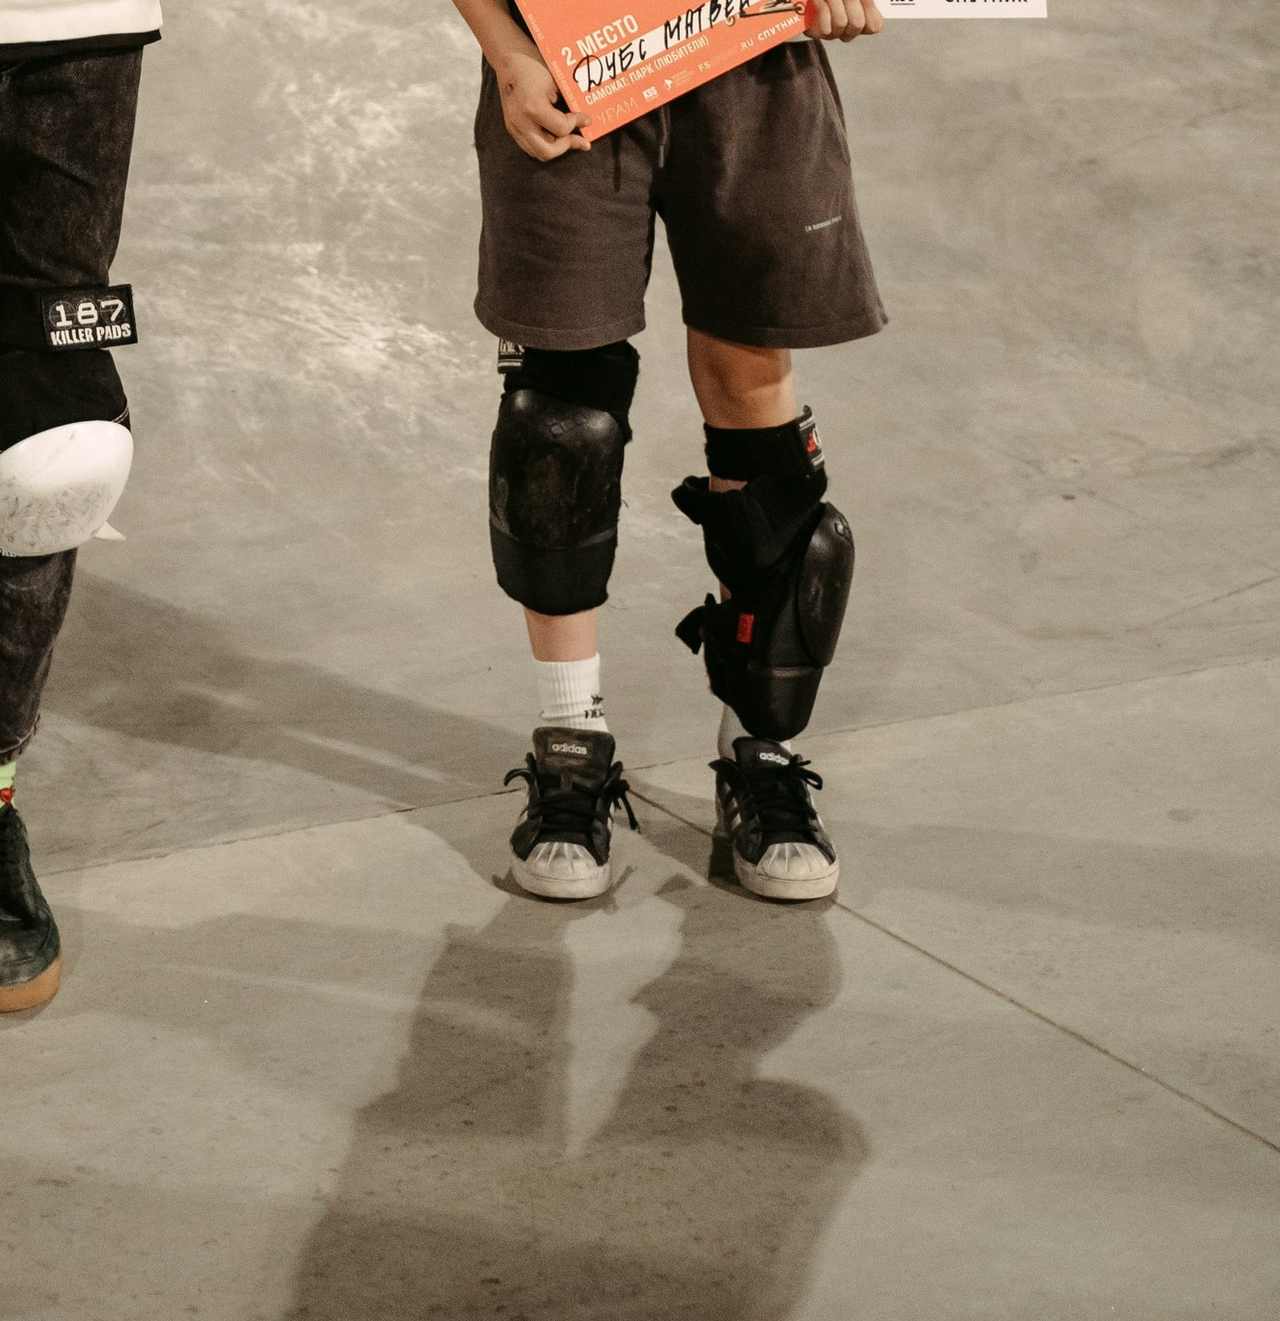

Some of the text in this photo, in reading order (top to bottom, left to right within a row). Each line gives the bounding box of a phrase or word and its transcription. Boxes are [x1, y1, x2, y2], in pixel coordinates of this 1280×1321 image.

[561, 47, 577, 66] 2
[576, 14, 639, 58] МЕСТО
[757, 14, 801, 41] СПУТНИК
[585, 79, 630, 106] САМОКАТ:
[629, 64, 654, 85] ПАРК
[654, 35, 710, 72] (ЛЮБИТЕЛИ)
[55, 299, 124, 327] 187
[50, 322, 132, 346] KILLER PADS
[551, 741, 588, 755] adidas
